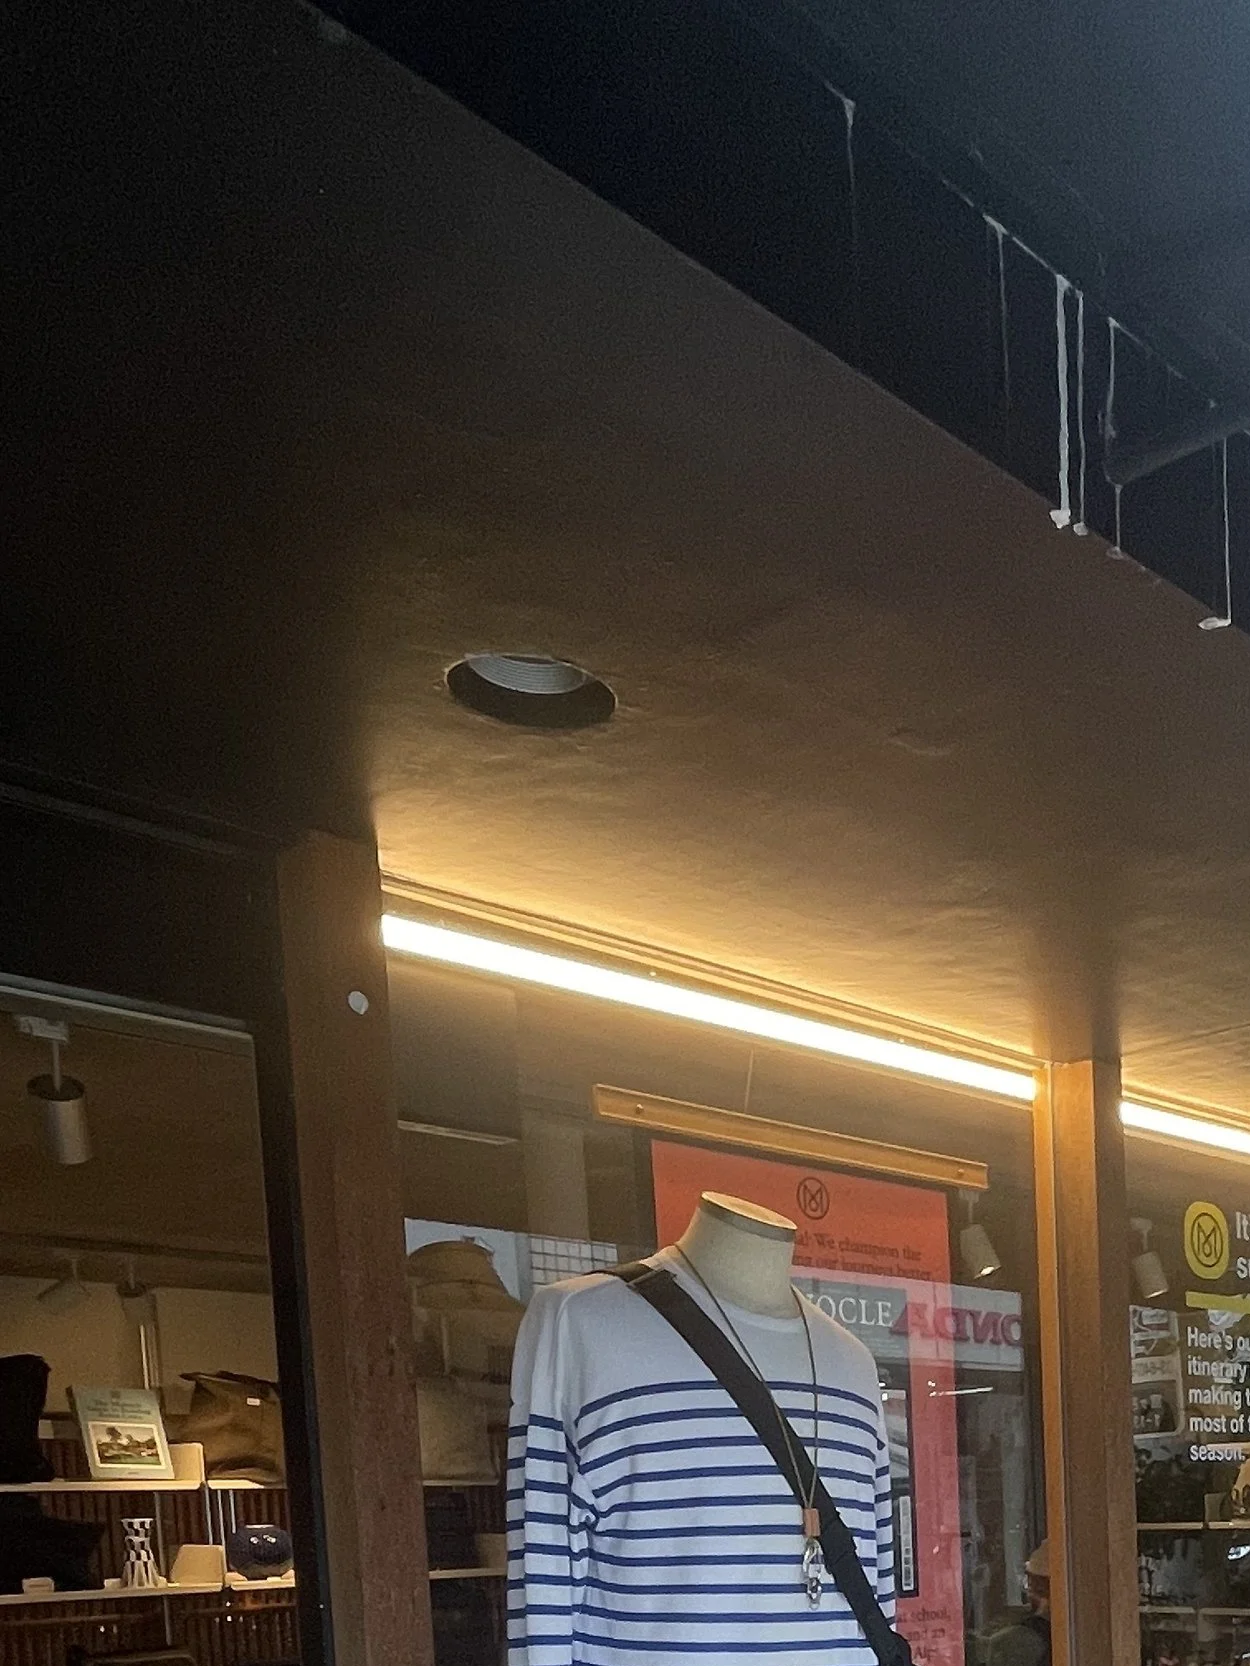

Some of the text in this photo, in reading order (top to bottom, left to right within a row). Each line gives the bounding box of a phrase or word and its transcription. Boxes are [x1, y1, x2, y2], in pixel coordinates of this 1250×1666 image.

[839, 1237, 899, 1260] champion
[903, 1245, 921, 1261] the
[806, 1294, 893, 1327] OCLE
[1187, 1326, 1233, 1351] Here's
[1188, 1355, 1247, 1383] itinerary
[1189, 1389, 1242, 1410] making
[1190, 1415, 1226, 1434] most
[1230, 1414, 1244, 1433] of
[1190, 1443, 1245, 1461] season.
